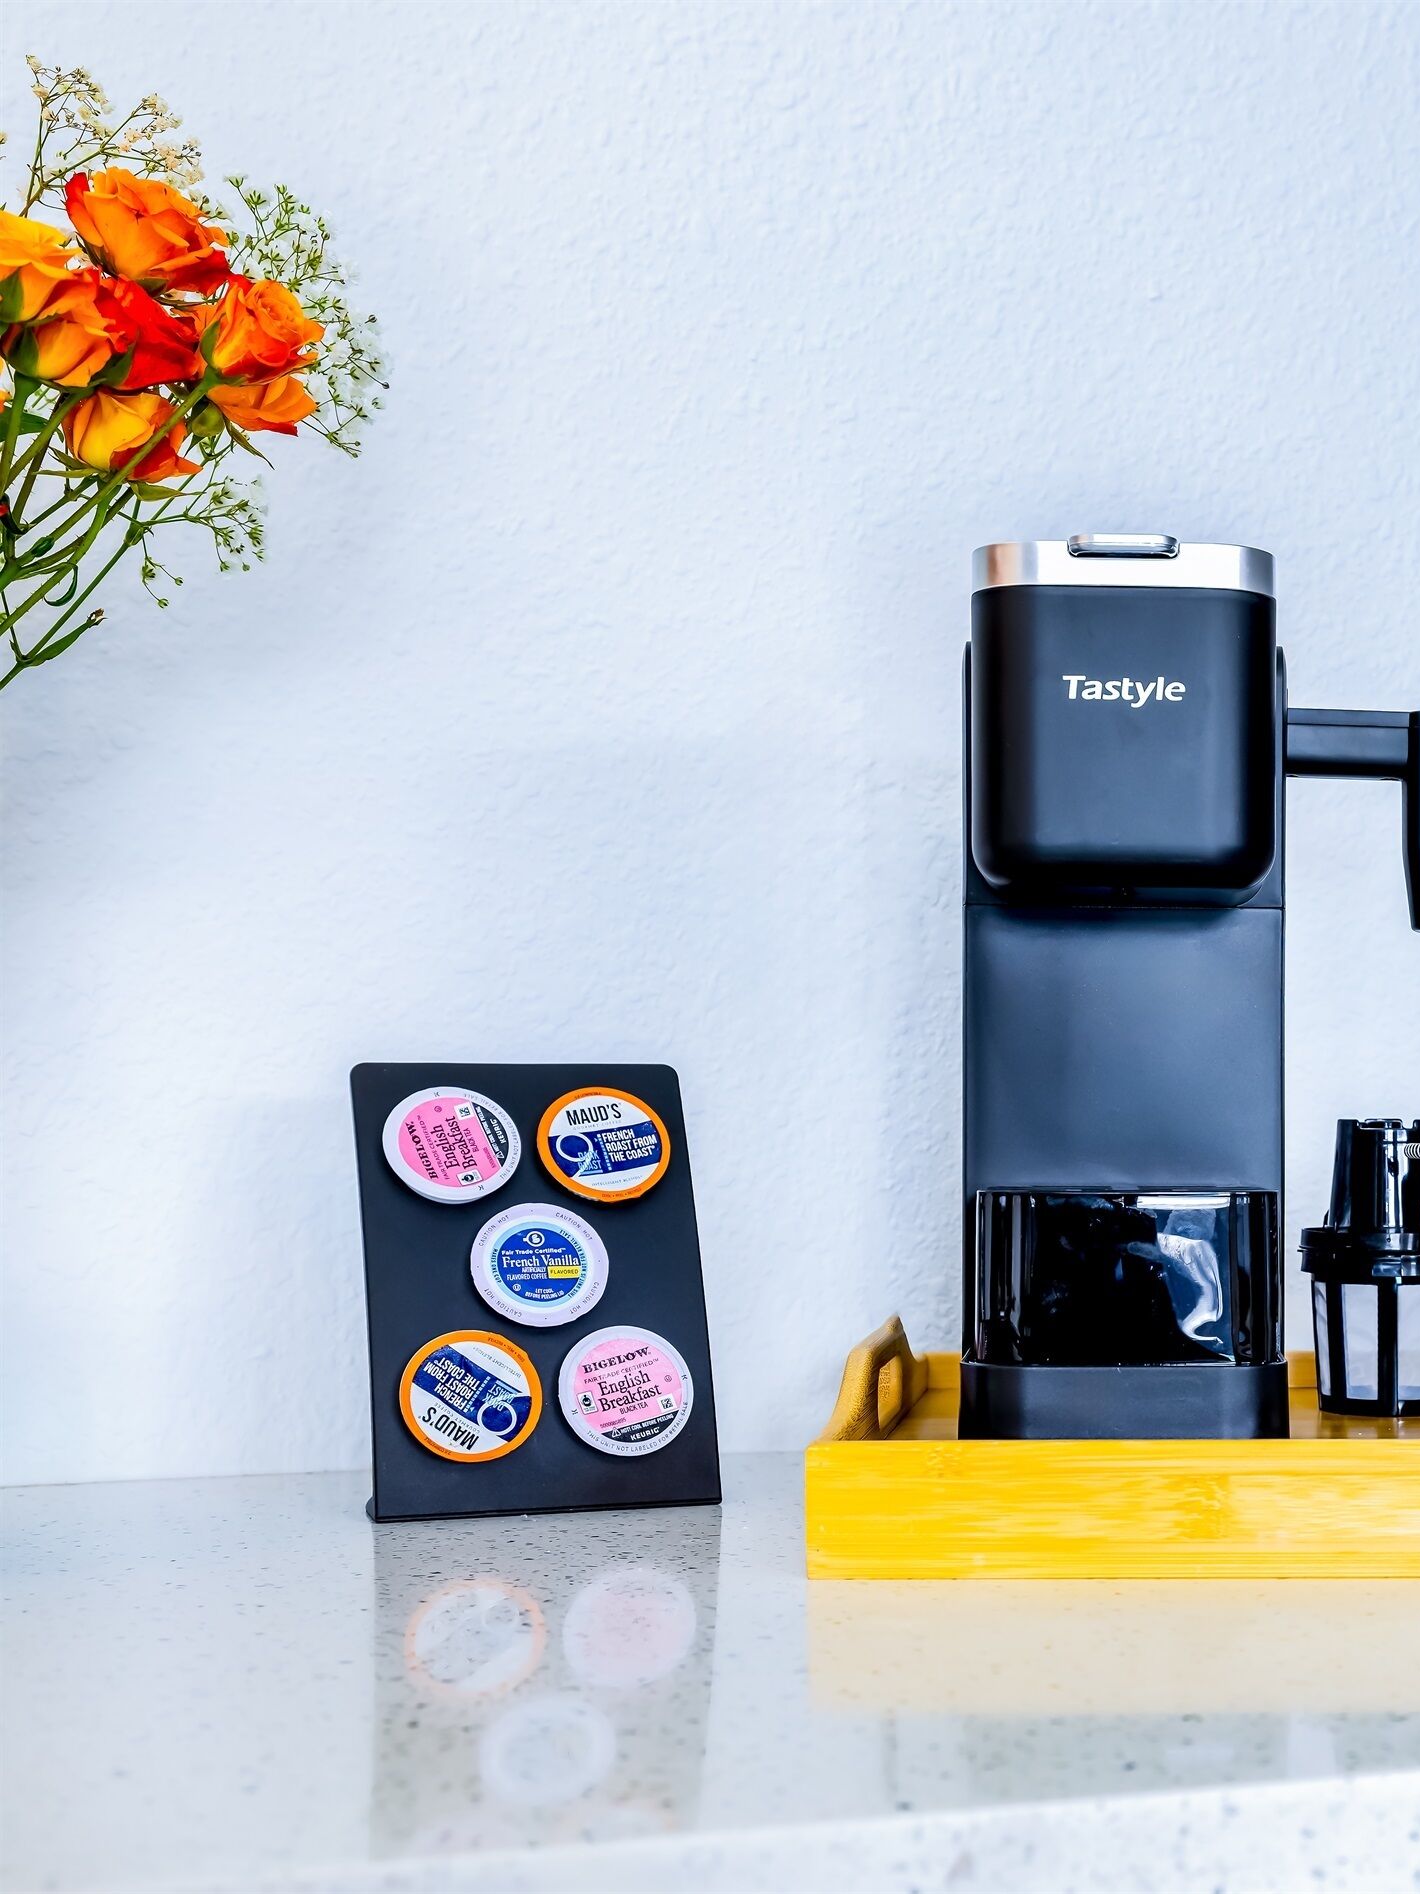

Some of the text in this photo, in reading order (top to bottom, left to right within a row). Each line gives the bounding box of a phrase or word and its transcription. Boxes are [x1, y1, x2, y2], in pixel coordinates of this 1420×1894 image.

[1062, 675, 1186, 708] Tastyle
[566, 1103, 621, 1126] MAUD'S
[405, 1121, 438, 1179] BIGELOW
[431, 1124, 460, 1169] English
[445, 1116, 478, 1169] Breakfast
[601, 1129, 635, 1143] FRENCH
[604, 1134, 658, 1153] ROAST FROM
[608, 1151, 626, 1163] THE
[479, 1214, 510, 1246] CAUTION HOT
[555, 1212, 593, 1241] CAUTION HOT
[502, 1254, 579, 1268] French Vanilla
[484, 1288, 523, 1318] CAUTION HOT
[568, 1288, 578, 1298] THIS
[569, 1281, 600, 1315] CAUTION HOT
[582, 1346, 649, 1374] BIGELOW
[423, 1361, 475, 1400] ROAST FROM
[462, 1372, 480, 1391] THE
[584, 1376, 598, 1385] FAIR
[598, 1370, 651, 1396] English
[434, 1382, 468, 1411] FRENCH
[598, 1384, 662, 1412] Breakfast
[619, 1401, 649, 1415] BLACK TEA
[421, 1406, 480, 1451] MAUD'S
[586, 1430, 599, 1441] THIS
[630, 1441, 658, 1452] LABELED
[658, 1434, 669, 1444] FOR
[669, 1417, 684, 1435] RETAIL
[681, 1401, 689, 1416] SALE
[630, 1427, 660, 1441] KEURIG
